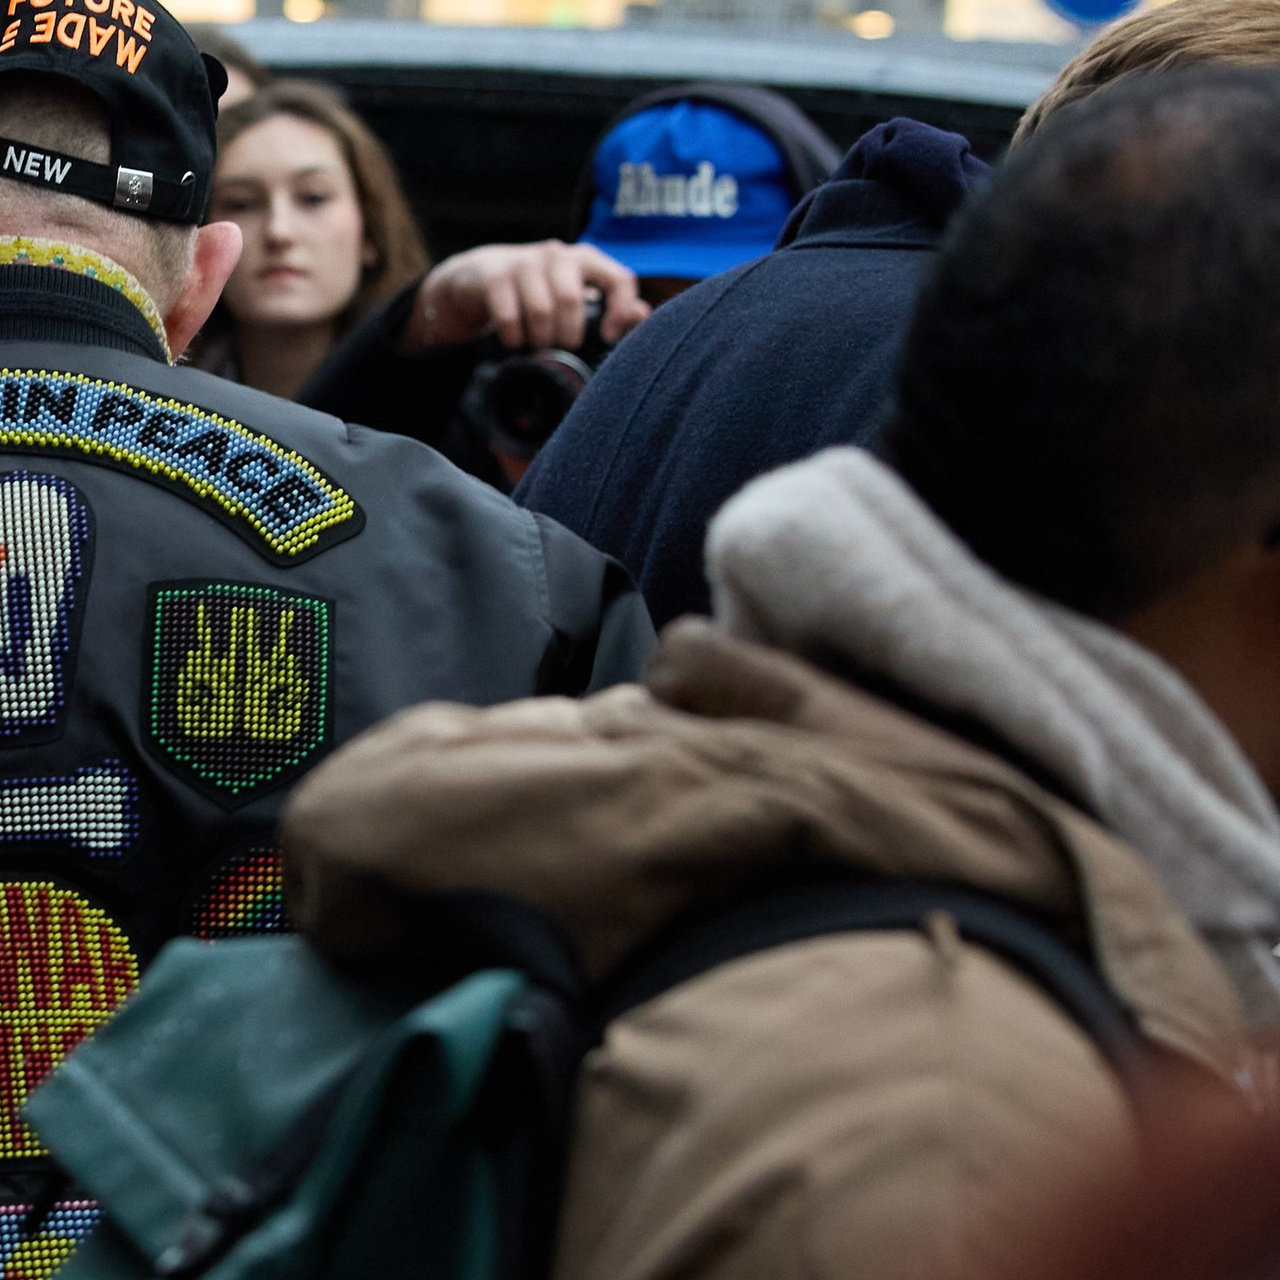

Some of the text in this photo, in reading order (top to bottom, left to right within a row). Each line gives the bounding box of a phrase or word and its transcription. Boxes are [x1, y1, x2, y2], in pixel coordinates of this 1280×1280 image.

[29, 10, 147, 75] MADE
[2, 145, 72, 185] NEW
[2, 380, 77, 422] IN
[90, 392, 320, 516] PEACE
